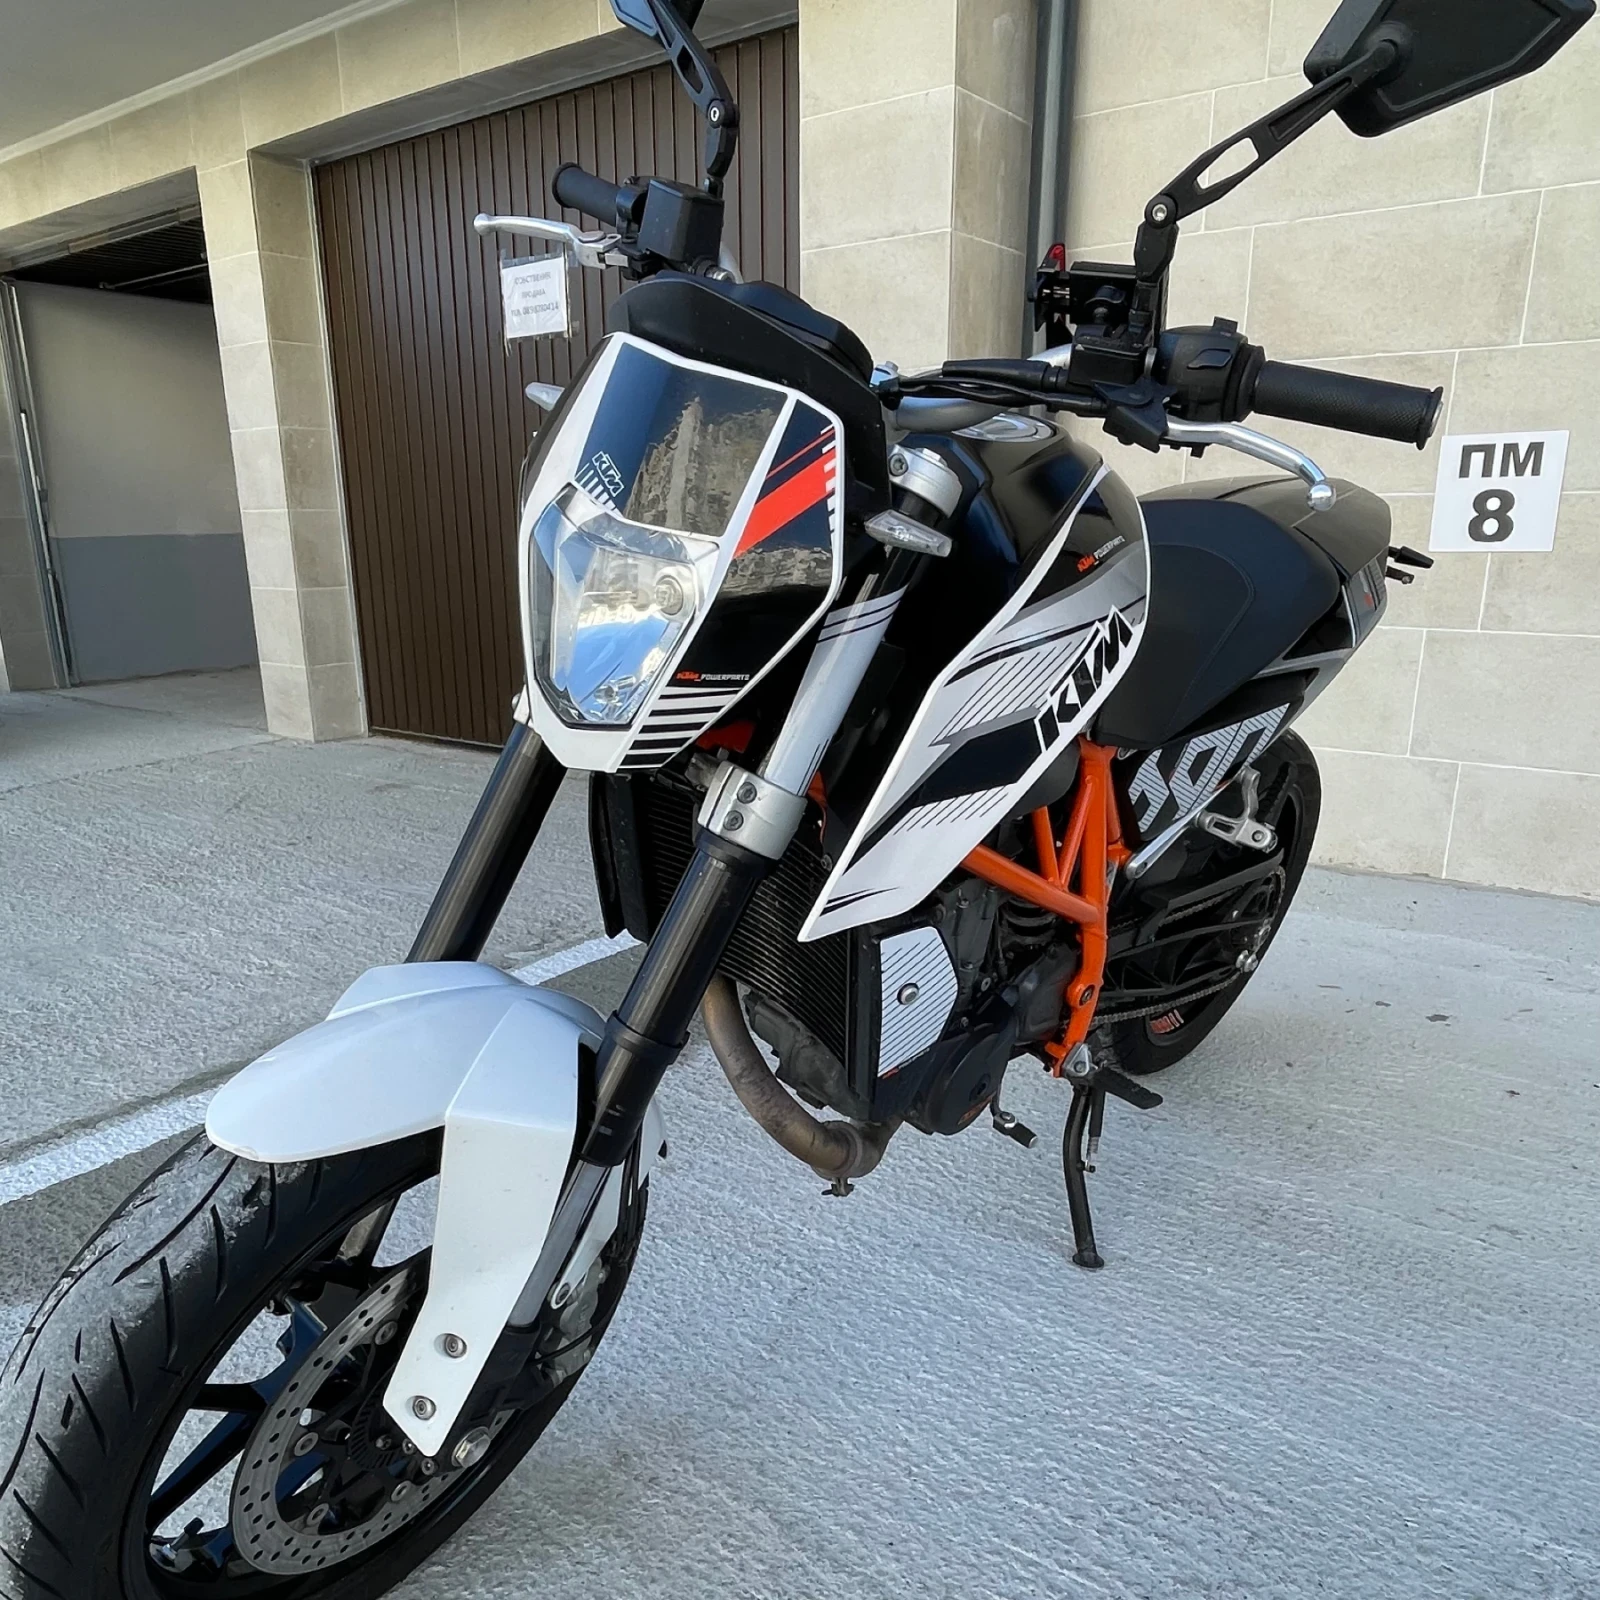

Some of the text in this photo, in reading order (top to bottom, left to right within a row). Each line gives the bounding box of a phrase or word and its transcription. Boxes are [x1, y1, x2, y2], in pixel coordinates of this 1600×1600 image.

[592, 451, 624, 497] KTM
[1458, 441, 1545, 479] ПМ
[1468, 488, 1515, 542] 8
[1035, 605, 1133, 751] KTM
